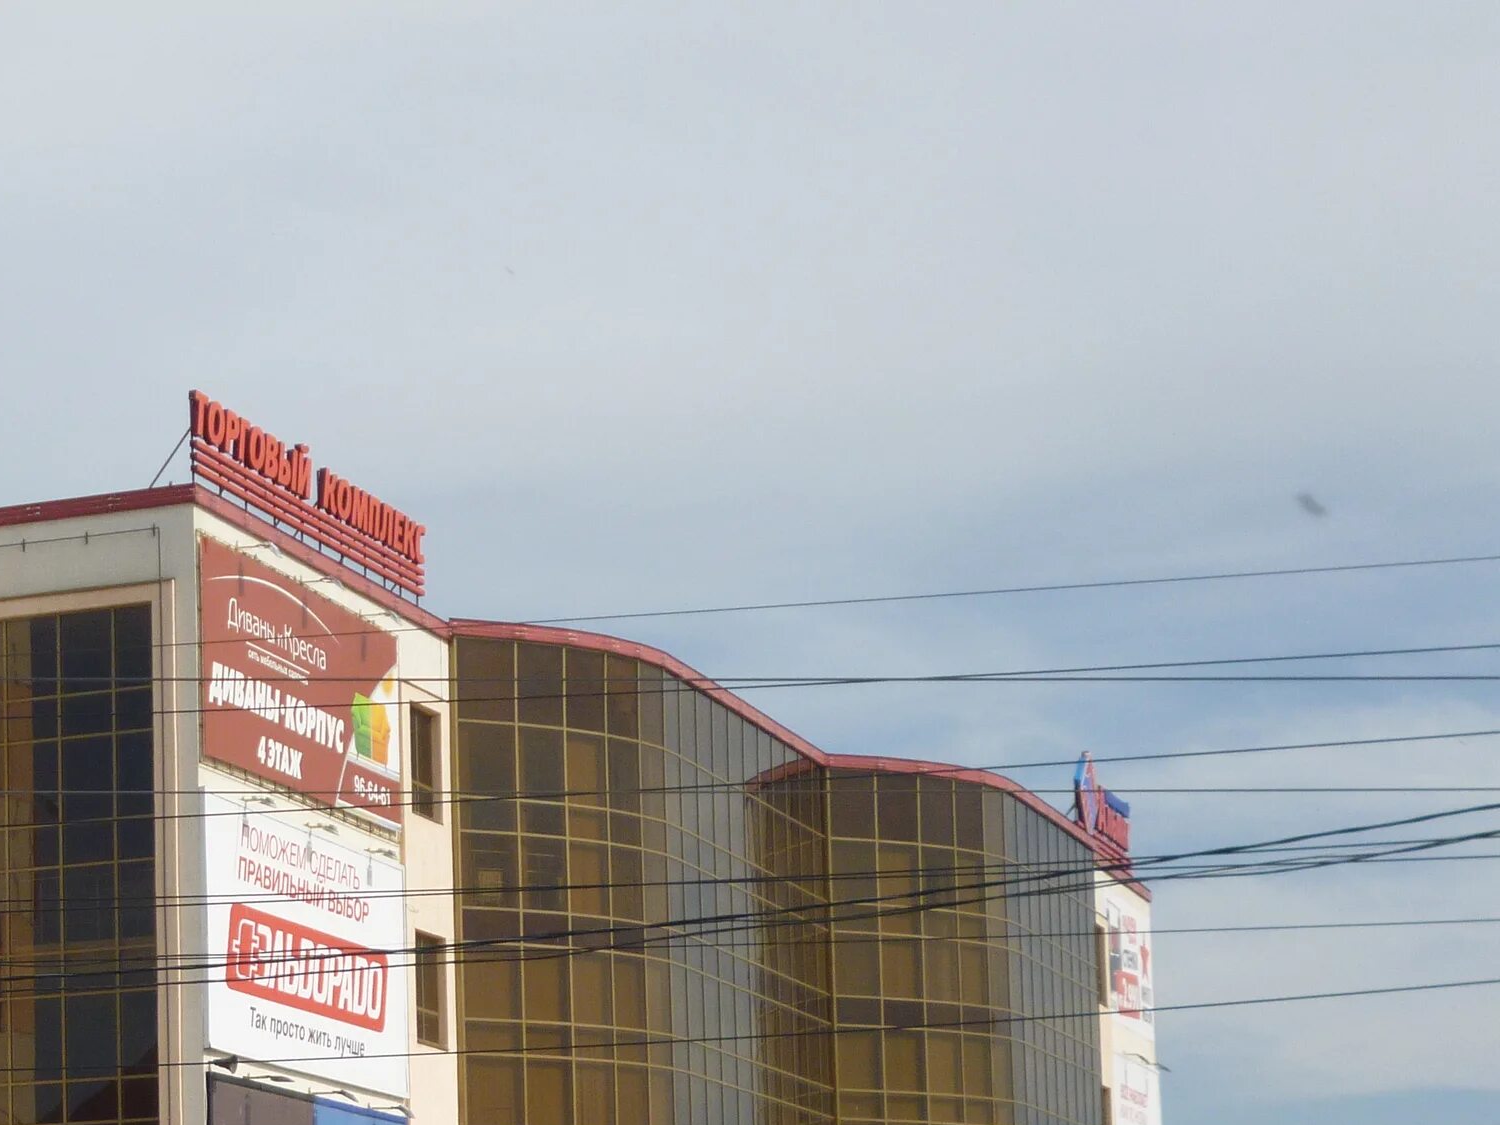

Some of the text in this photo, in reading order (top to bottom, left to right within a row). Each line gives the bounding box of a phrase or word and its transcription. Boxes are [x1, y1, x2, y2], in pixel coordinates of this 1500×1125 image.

[189, 390, 426, 564] ТОРГОВЫЙ КОМПЛЕКС
[227, 597, 276, 645] Диваны
[283, 624, 327, 670] Кресла
[209, 661, 345, 754] ДИВАНЫ КОРПУС
[257, 736, 303, 780] 4 ЭТАЖ
[238, 856, 370, 923] ПРАВИЛЬНЫЙ ВЫБОР
[241, 823, 361, 890] ПОМОЖЕМ СДЕЛАТЬ
[249, 1006, 366, 1057] Так просто жить лучше
